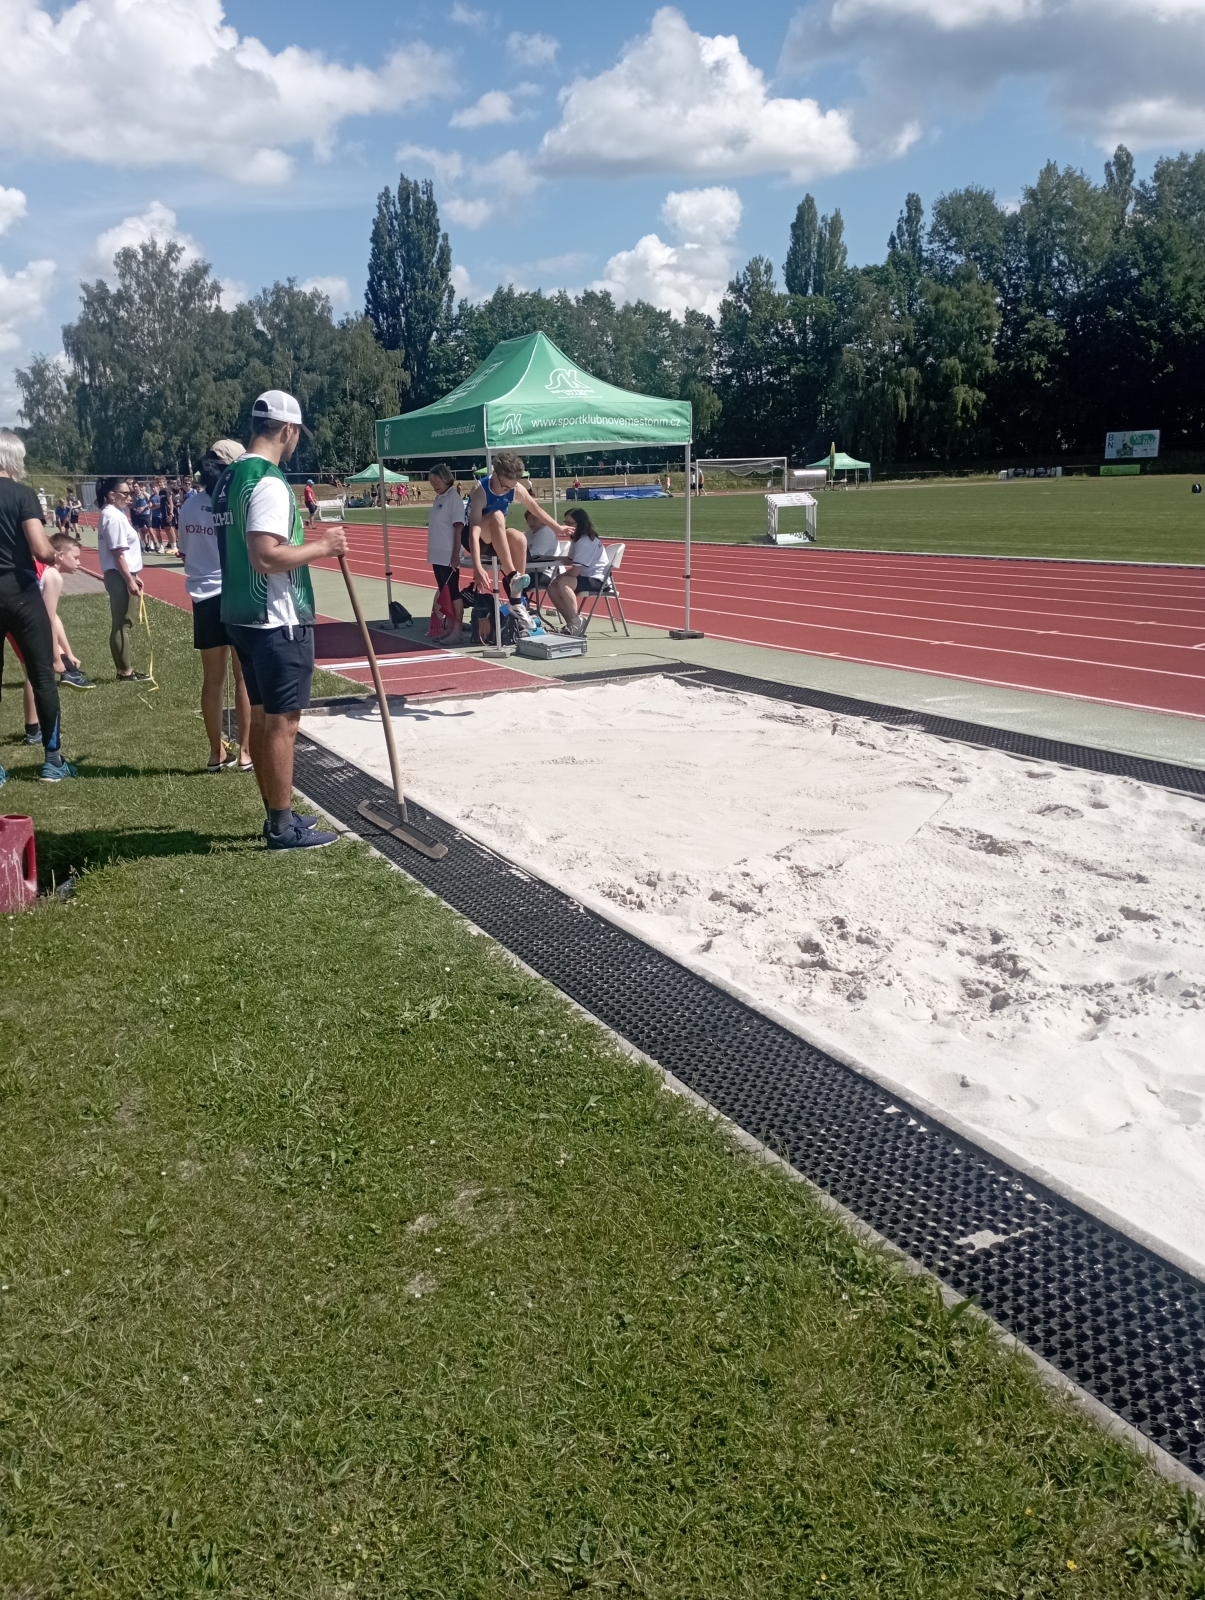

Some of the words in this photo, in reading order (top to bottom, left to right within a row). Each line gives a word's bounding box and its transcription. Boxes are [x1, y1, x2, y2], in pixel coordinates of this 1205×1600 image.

[498, 413, 524, 436] SK
[531, 413, 681, 428] www.sportklubnovemestonm.cz
[185, 525, 214, 535] ROZHO
